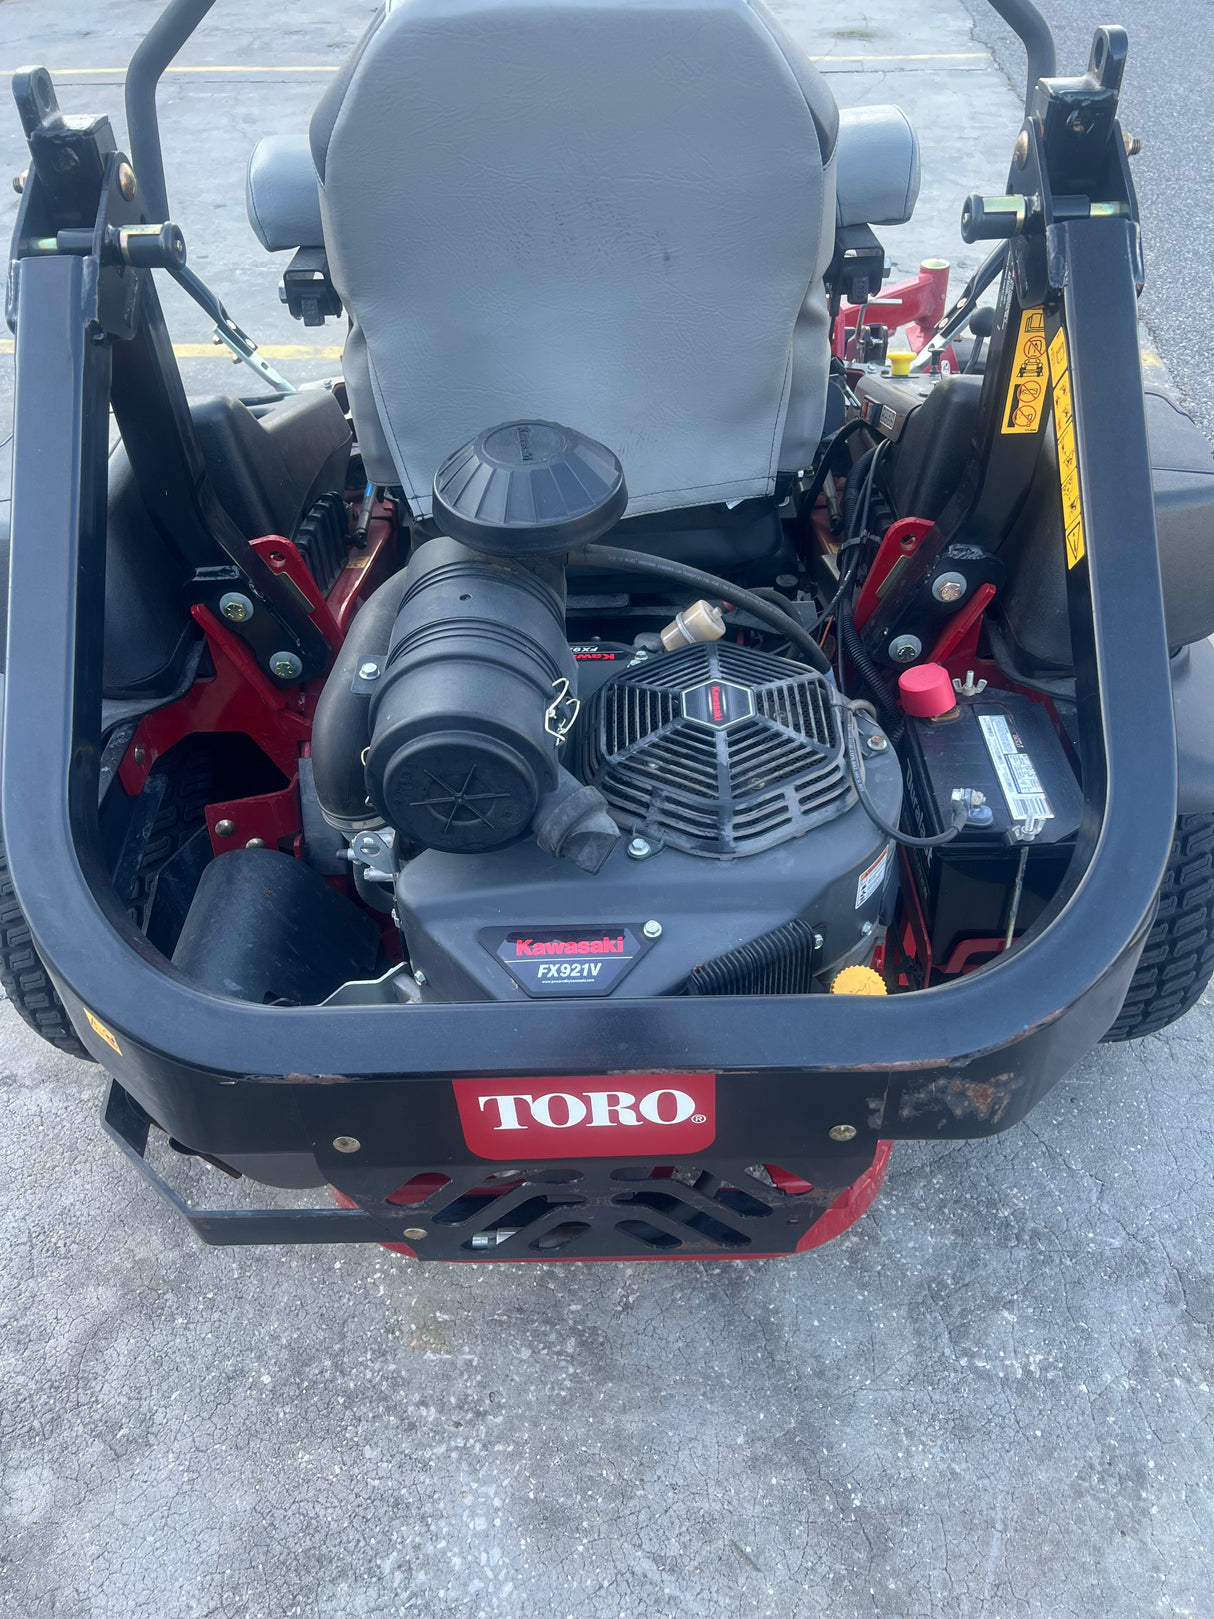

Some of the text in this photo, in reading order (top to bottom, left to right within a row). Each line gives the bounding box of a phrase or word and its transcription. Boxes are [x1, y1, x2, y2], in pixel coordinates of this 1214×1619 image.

[711, 686, 724, 721] Kawasaki
[516, 936, 624, 956] Kawasaki
[537, 963, 602, 978] FX921V
